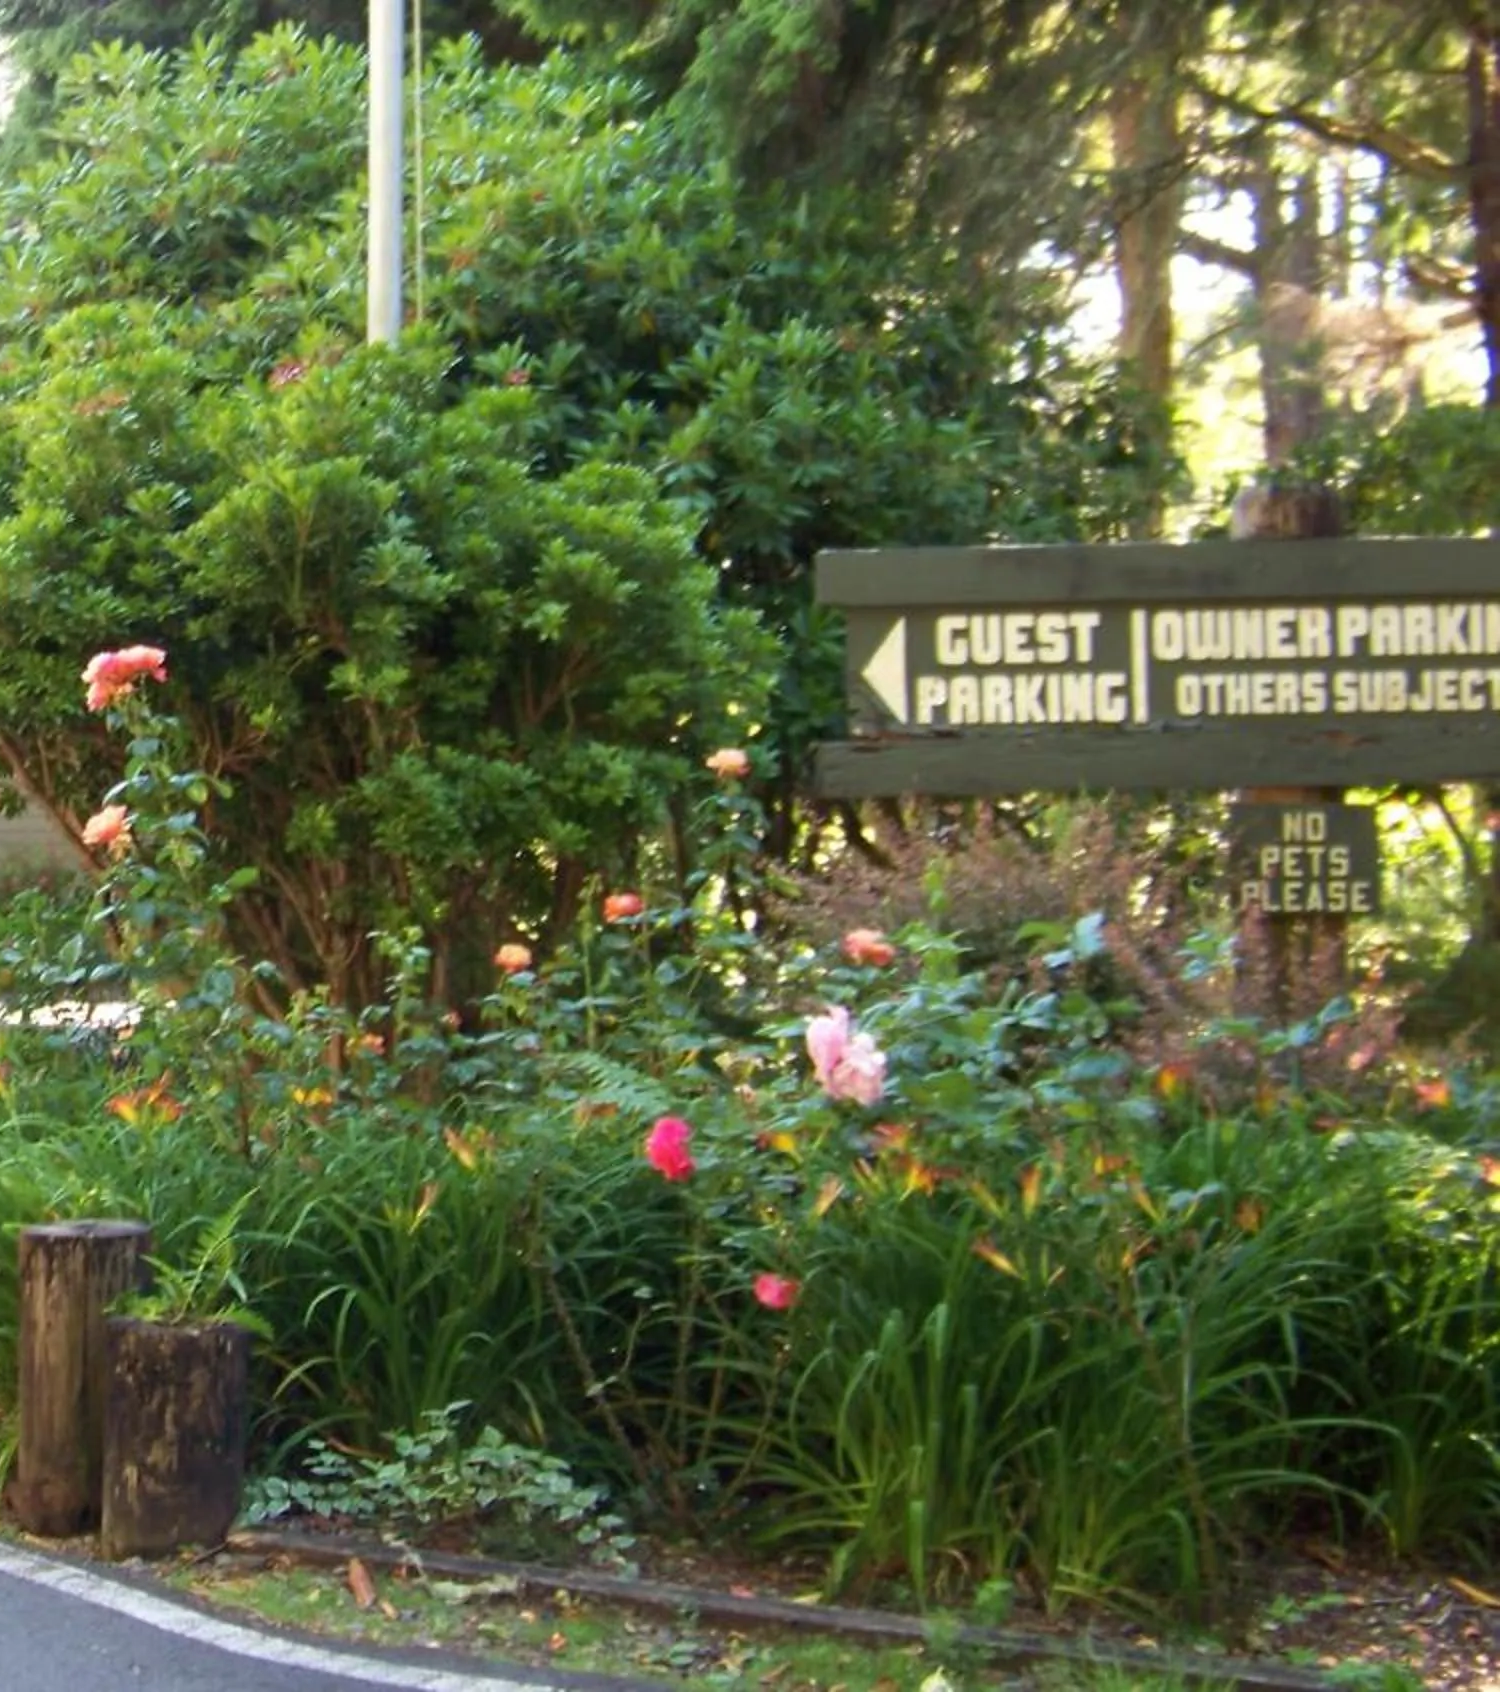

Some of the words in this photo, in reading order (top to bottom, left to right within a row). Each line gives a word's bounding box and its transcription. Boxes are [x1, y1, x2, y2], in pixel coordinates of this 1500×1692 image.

[935, 611, 1101, 666] GUEST
[1152, 607, 1331, 661] OWNER
[915, 672, 1127, 725] PARKING
[1175, 670, 1327, 716] OTHERS
[1282, 811, 1326, 842] NO
[1260, 845, 1350, 877] PETS
[1240, 880, 1371, 912] PLEASE
